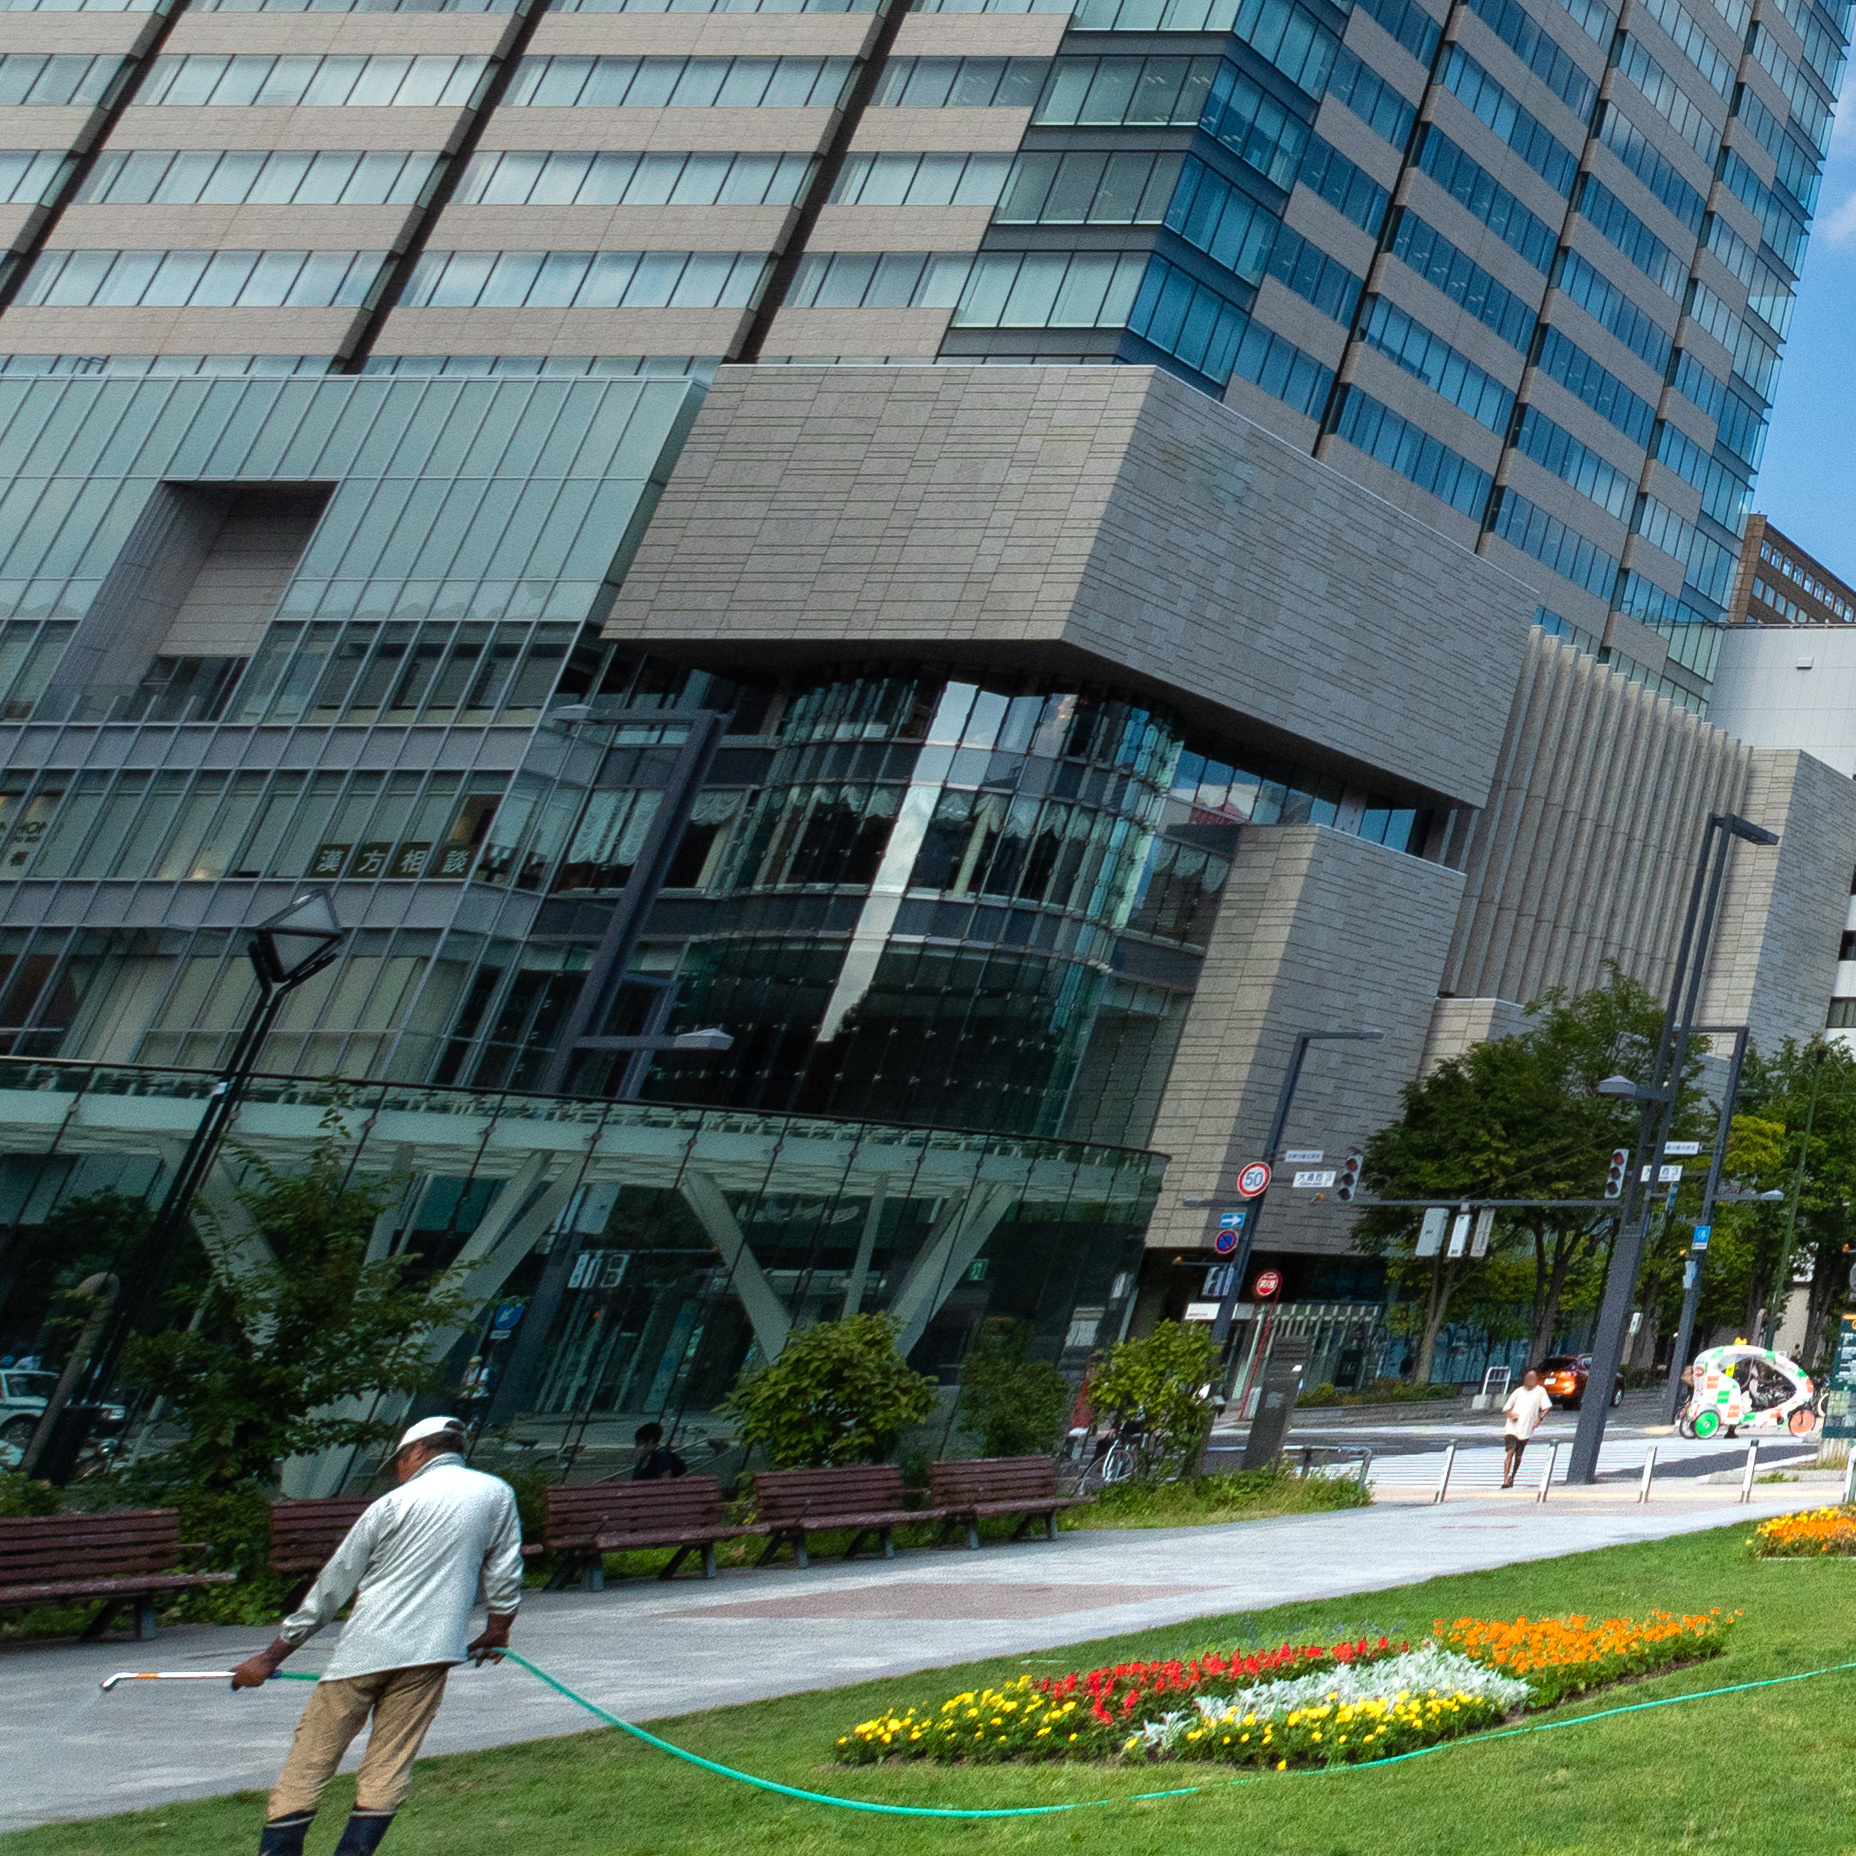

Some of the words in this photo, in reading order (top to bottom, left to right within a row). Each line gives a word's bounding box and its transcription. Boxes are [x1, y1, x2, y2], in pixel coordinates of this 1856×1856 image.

[316, 849, 470, 873] 漢方相談
[1244, 1171, 1264, 1187] 50
